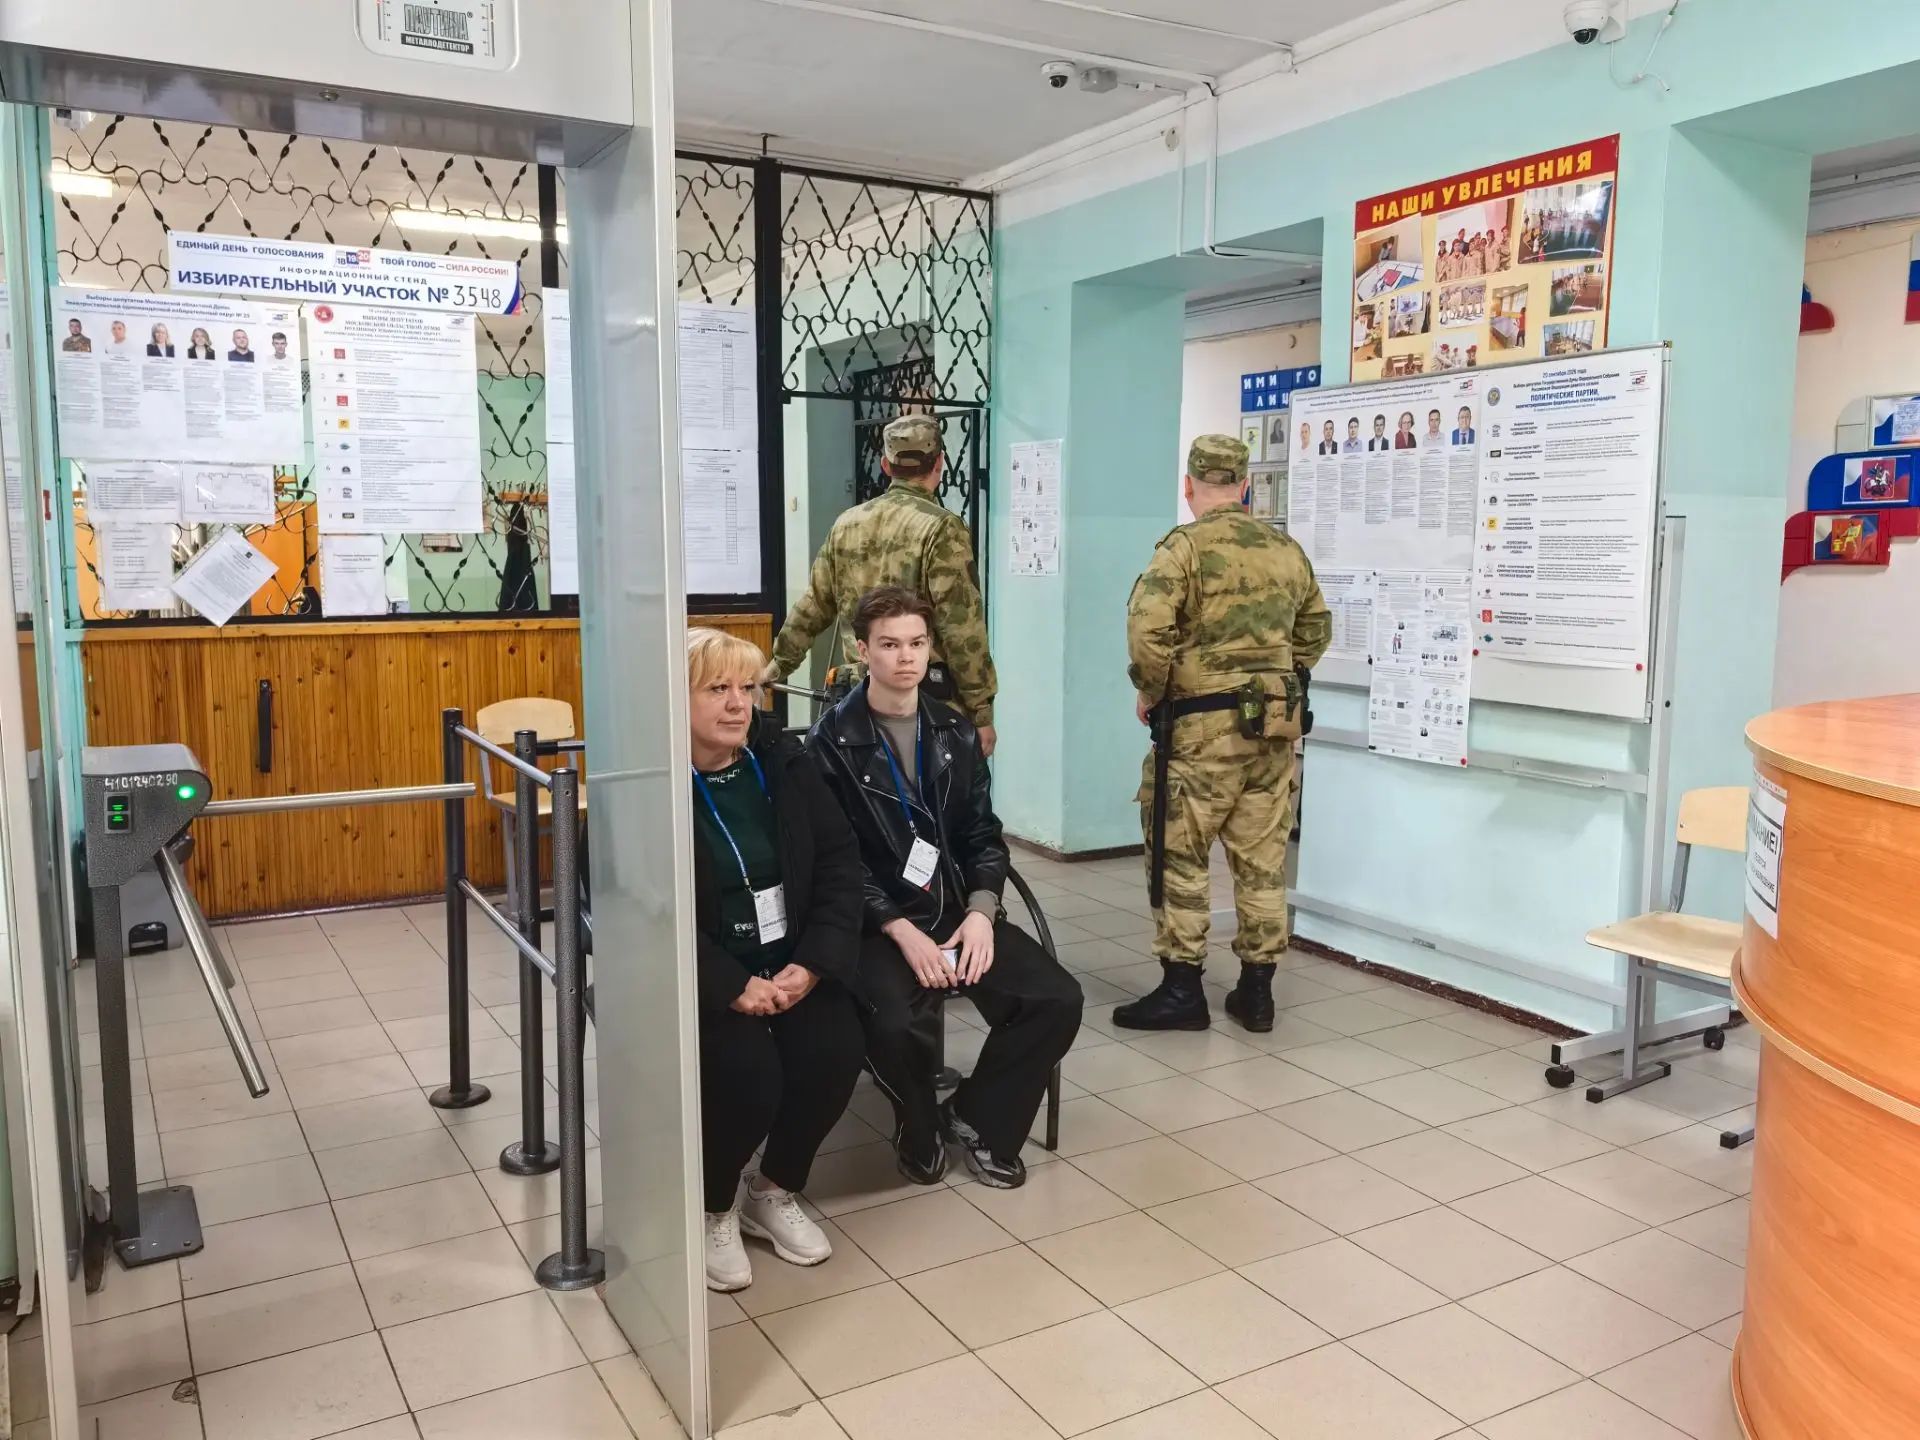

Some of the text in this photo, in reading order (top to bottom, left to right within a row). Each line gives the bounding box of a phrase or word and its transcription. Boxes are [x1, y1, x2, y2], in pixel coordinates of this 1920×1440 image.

[404, 4, 469, 40] ПАУТИНА
[406, 36, 470, 52] МЕТАЛЛОДЕТЕКТОР
[1372, 150, 1592, 223] НАШИ УВЛЕЧЕНИЯ
[176, 240, 324, 259] ЕДИНЫЙ ДЕНЬ ГОЛОСОВАНИЯ
[280, 266, 428, 285] ИНФОРМАЦИОННЫЙ СТЕНД
[380, 257, 404, 266] ТВОЙ
[407, 260, 436, 269] ГОЛОС
[446, 264, 469, 272] СИЛА
[472, 266, 509, 276] РОССИИ!
[178, 270, 501, 308] ИЗБИРАТЕЛЬНЫЙ УЧАСТОК № 3548
[1243, 374, 1277, 389] ИМИ
[1531, 391, 1575, 401] ПОЛИТИЧЕСКИЕ
